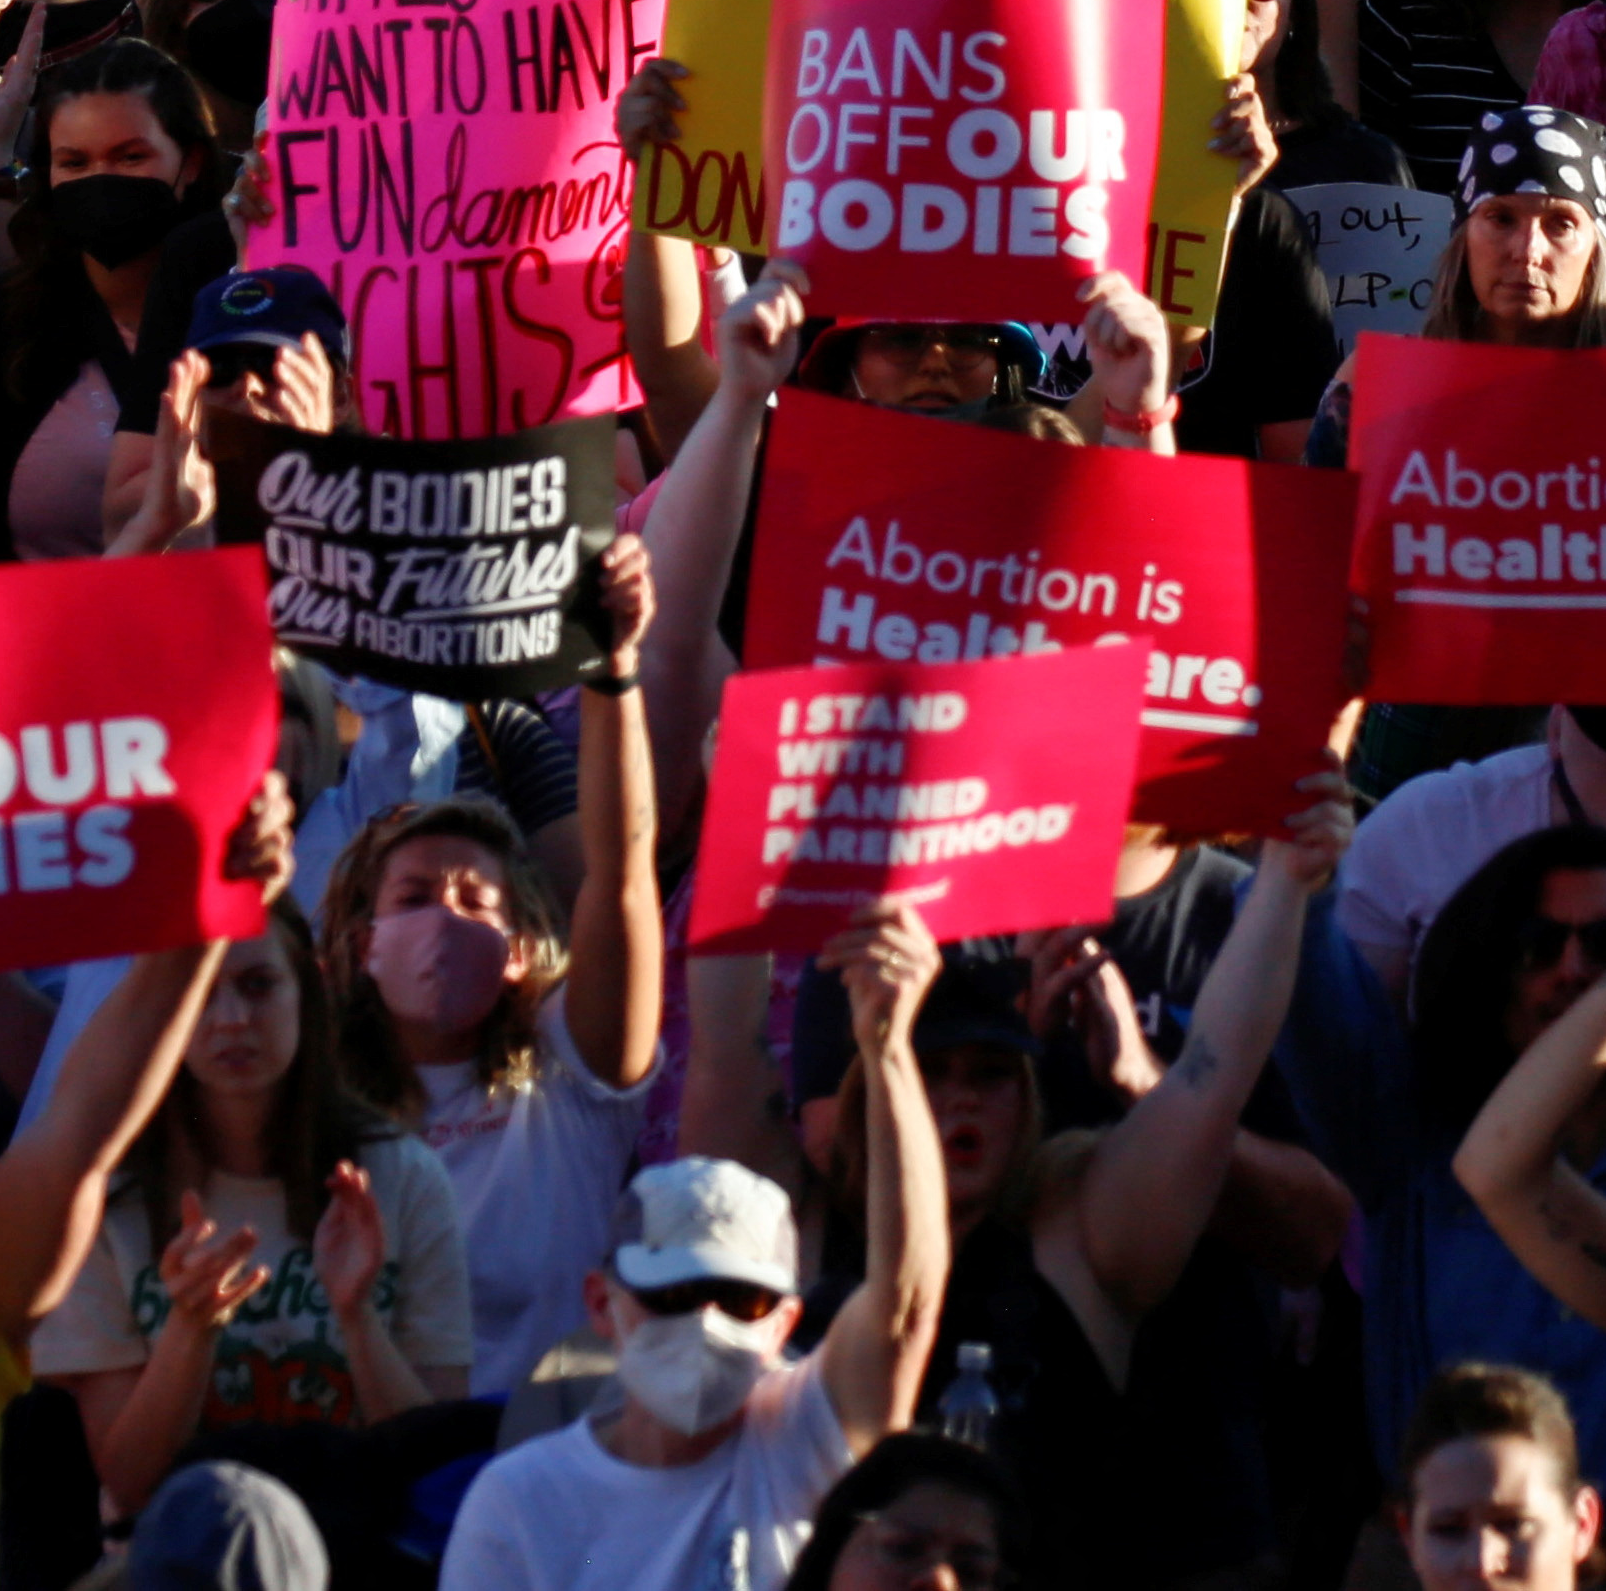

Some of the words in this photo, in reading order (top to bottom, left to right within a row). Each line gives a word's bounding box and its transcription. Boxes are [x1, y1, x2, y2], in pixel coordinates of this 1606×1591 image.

[276, 20, 412, 120] WANT
[428, 16, 486, 115] TO
[796, 27, 1006, 103] BANS
[786, 103, 933, 176] OFF
[946, 109, 1127, 181] OUR
[777, 180, 1109, 259] BODIES
[258, 452, 362, 529] Our
[370, 457, 566, 538] BODIES
[266, 525, 376, 597] OUR
[379, 525, 580, 611] Futures
[825, 517, 1118, 617] Abortion
[1136, 564, 1183, 624] is
[266, 577, 351, 633] Our
[355, 610, 561, 665] ABORTIONS
[779, 699, 798, 736] I
[806, 692, 967, 734] STAND
[778, 739, 904, 778] WITH
[763, 803, 1073, 865] PARENTHOOD
[768, 777, 989, 821] PLANNED
